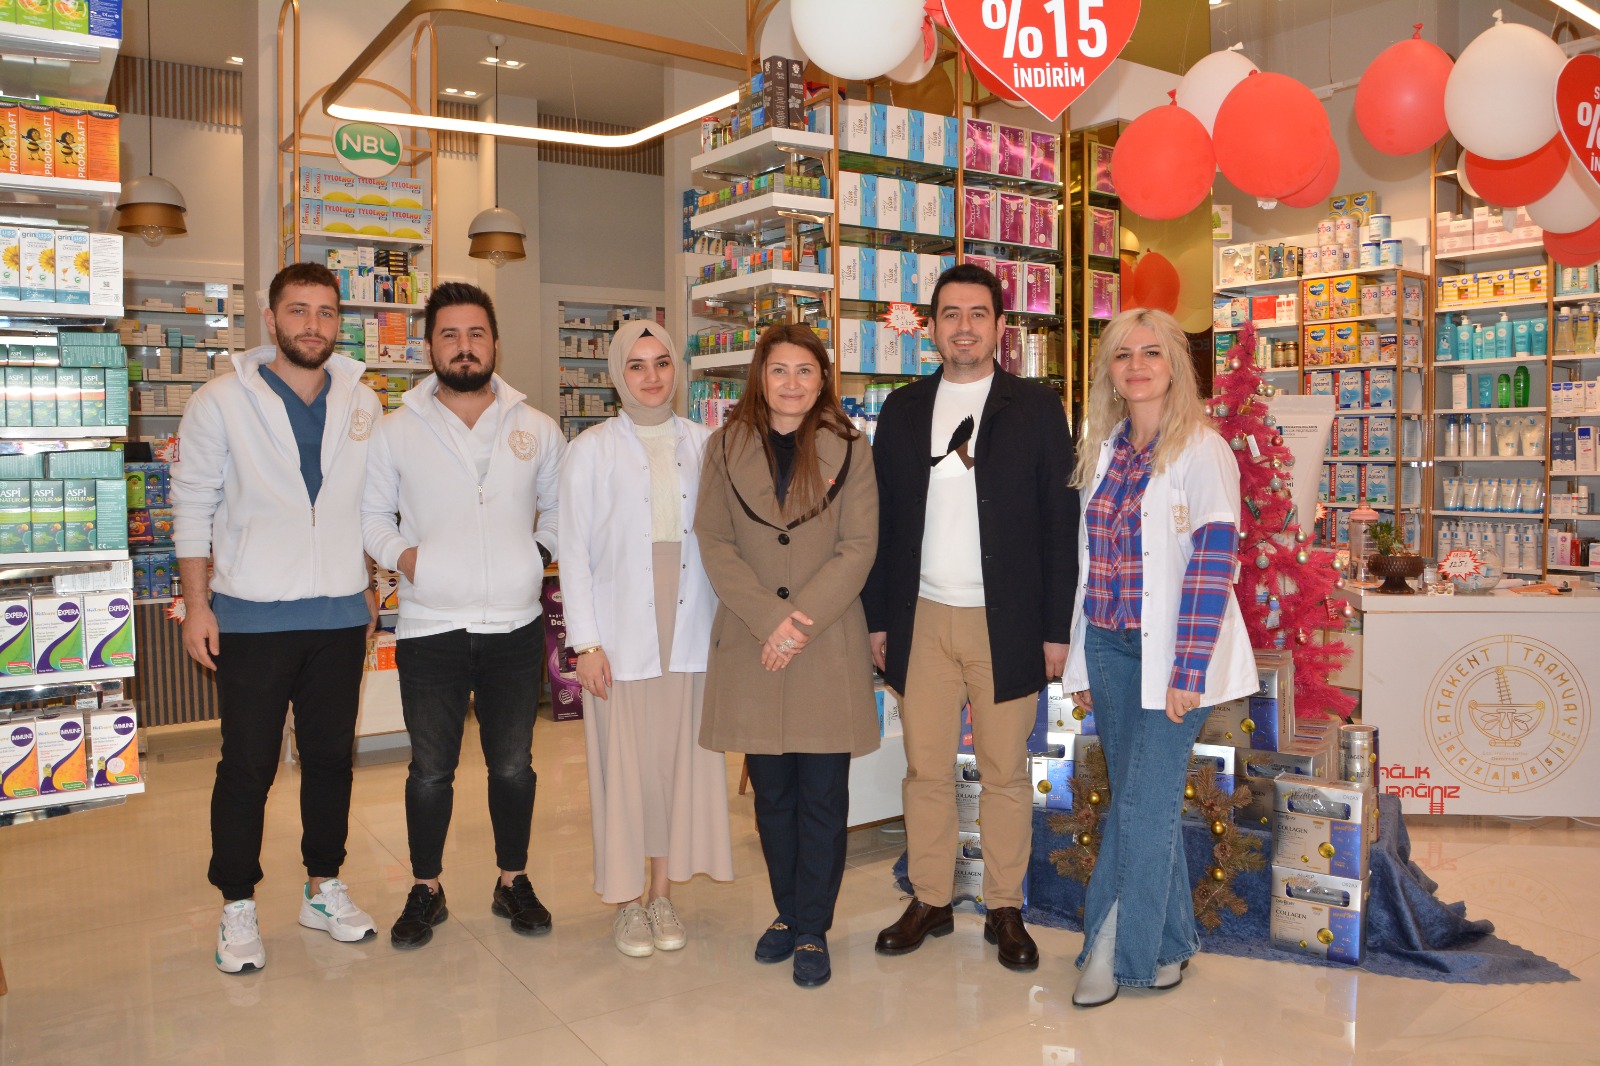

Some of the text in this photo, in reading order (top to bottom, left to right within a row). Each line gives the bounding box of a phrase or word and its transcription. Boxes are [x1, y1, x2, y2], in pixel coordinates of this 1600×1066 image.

[982, 0, 1108, 58] %15
[1013, 62, 1085, 88] İNDİRİM
[78, 119, 86, 178] PROPOLSAFT
[342, 132, 396, 157] NBL
[324, 174, 355, 183] TYLOLHOT
[358, 178, 388, 186] TYLOLHOT
[391, 181, 422, 190] TYLOLHOT
[325, 204, 356, 214] TYLOLHOT
[358, 208, 388, 217] TYLOLHOT
[392, 211, 422, 220] TYLOLHOT
[5, 611, 28, 619] EXPERA
[1437, 648, 1490, 723] ATAKENT
[1380, 764, 1430, 779] AĞLIK
[1386, 783, 1460, 799] RAĞINIZ
[1278, 824, 1308, 834] COLLAGEN
[1275, 909, 1307, 919] COLLAGEN
